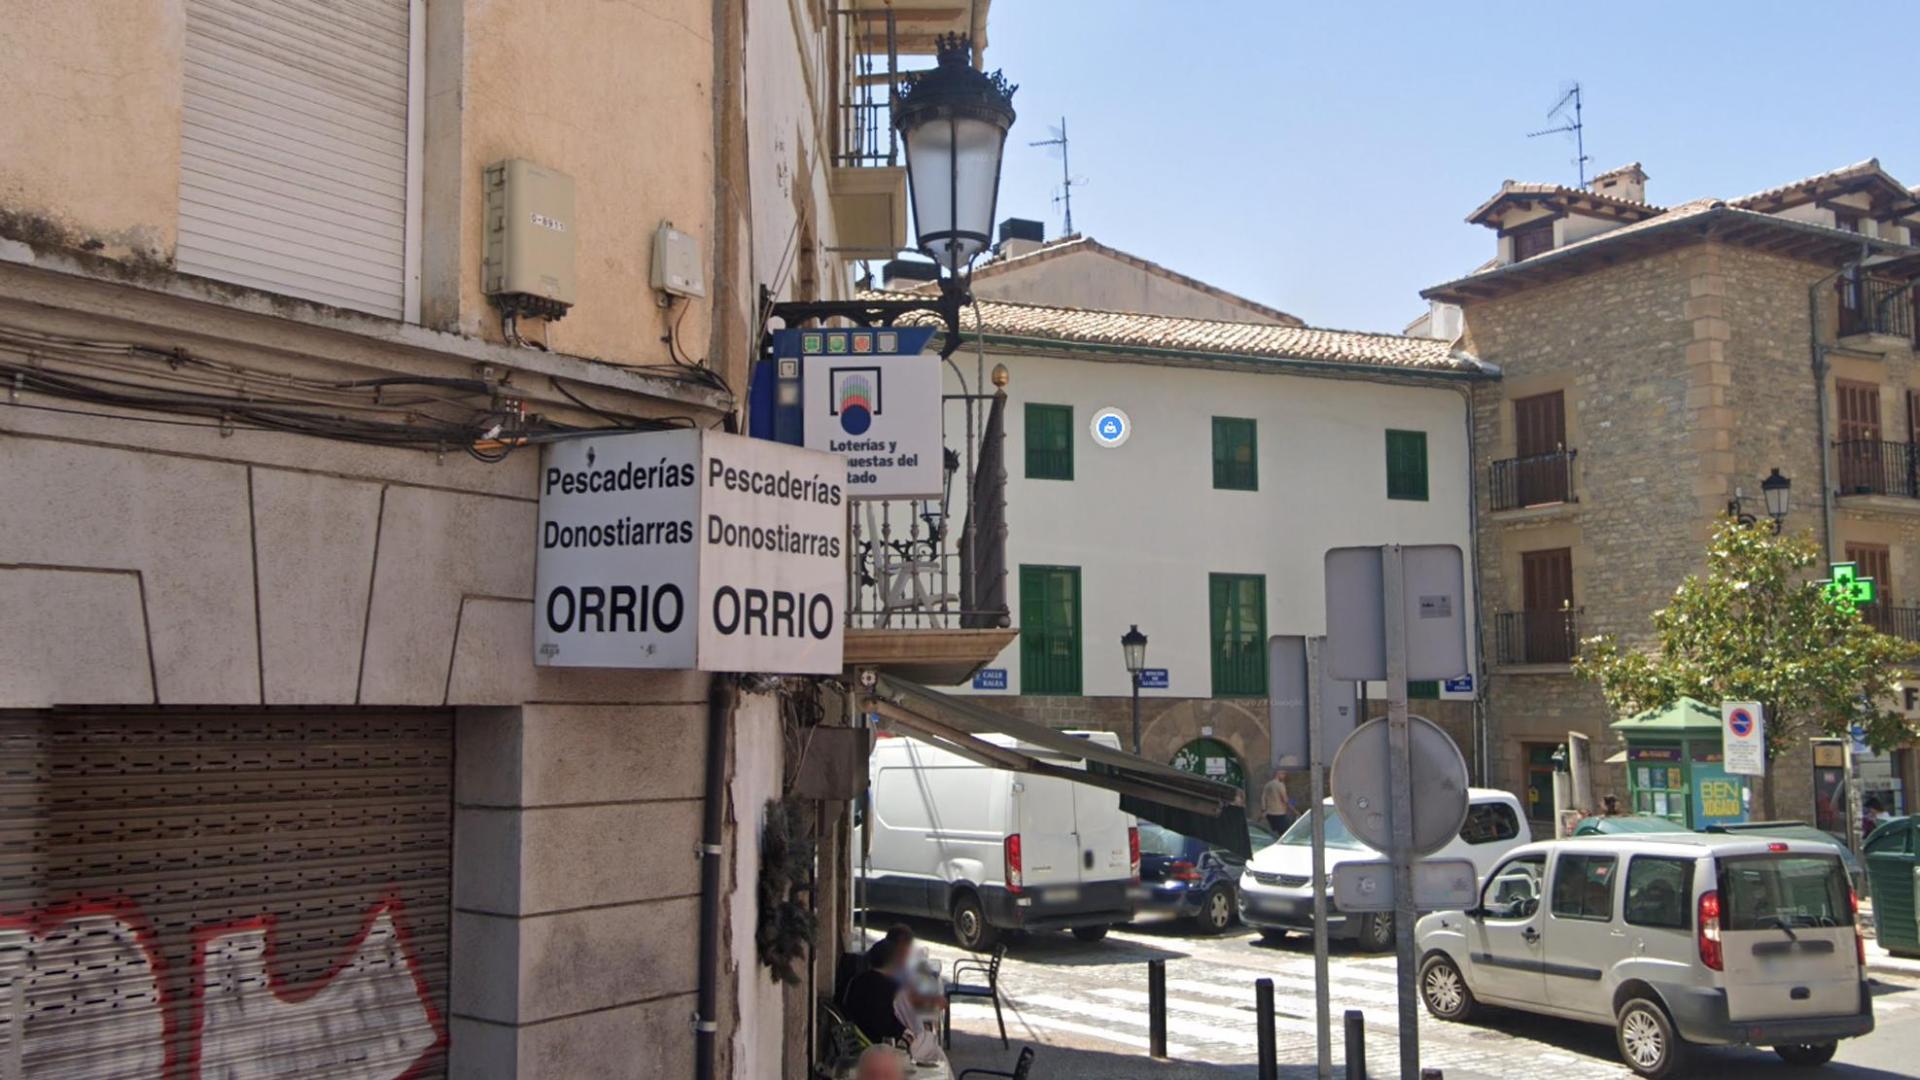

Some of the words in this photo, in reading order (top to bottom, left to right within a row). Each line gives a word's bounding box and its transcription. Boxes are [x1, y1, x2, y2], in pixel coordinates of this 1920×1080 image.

[830, 439, 885, 452] Loterías
[889, 442, 897, 454] y
[847, 455, 894, 468] uestas
[897, 453, 918, 467] del
[546, 457, 695, 497] Pescaderías
[710, 457, 841, 506] Pescaderías
[847, 470, 878, 484] tado
[544, 516, 694, 549] Donostiarras
[709, 514, 841, 558] Donostiarras
[547, 583, 685, 634] ORRIO
[713, 586, 834, 640] ORRIO
[1700, 782, 1739, 800] BEN
